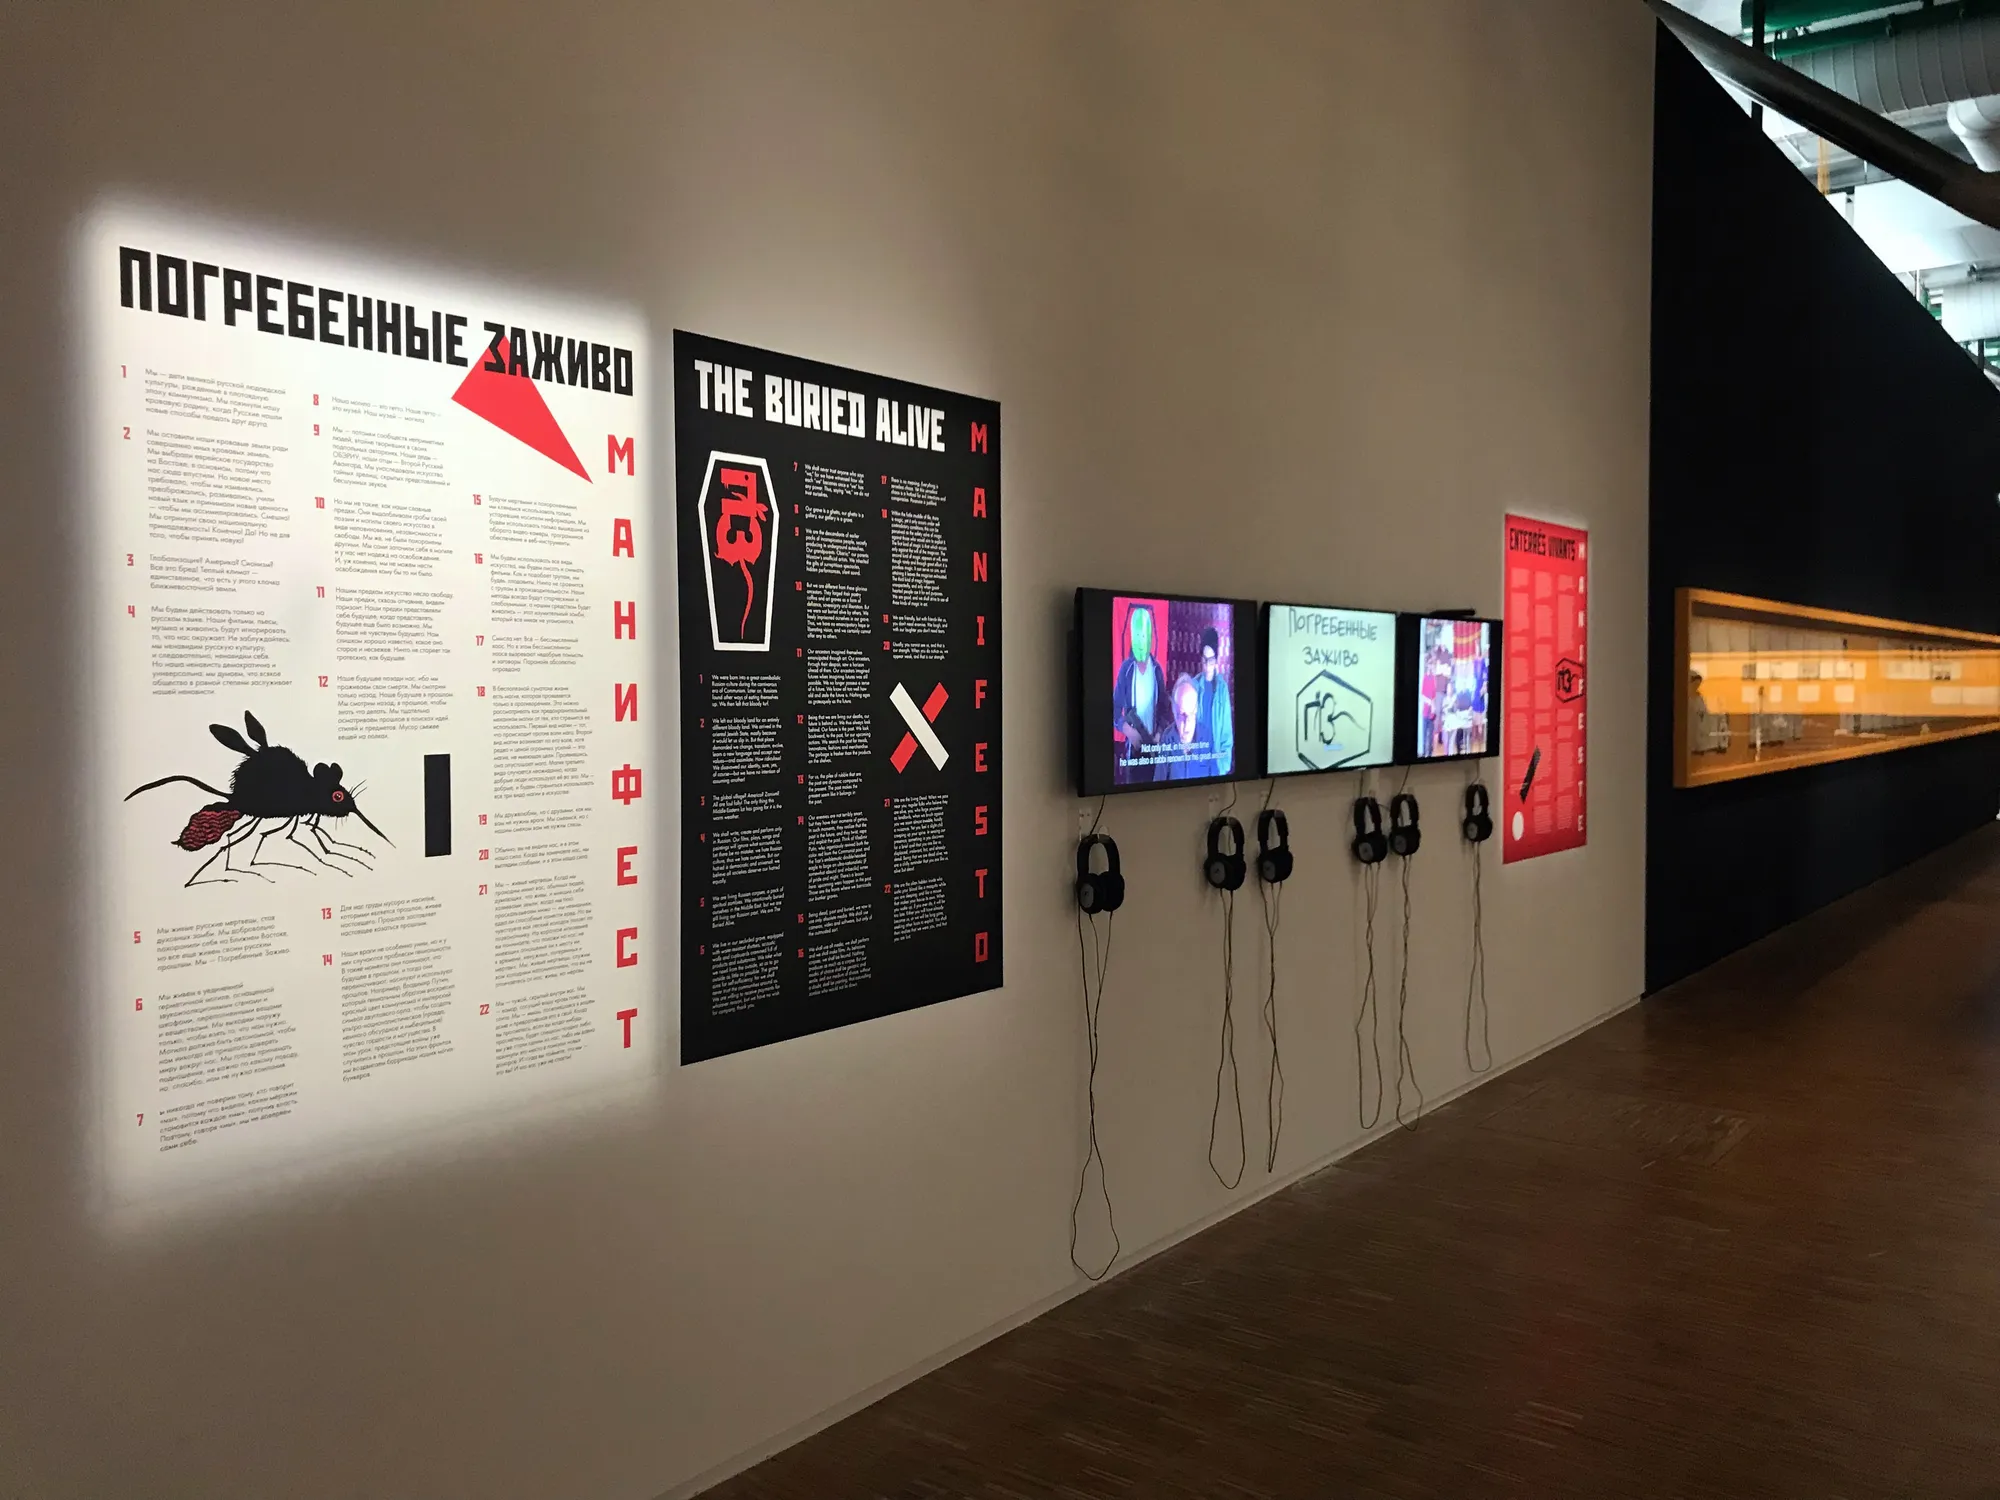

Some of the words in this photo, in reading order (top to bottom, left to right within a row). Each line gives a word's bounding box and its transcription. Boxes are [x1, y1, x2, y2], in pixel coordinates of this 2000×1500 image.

[119, 246, 468, 367] ПОГРЕБЕННЫЕ
[484, 321, 633, 396] ЗАЖИВО
[121, 366, 127, 378] 1
[313, 394, 319, 406] 8
[694, 359, 753, 418] THE
[765, 374, 866, 438] BURIED
[876, 397, 945, 452] ALIVE
[123, 426, 131, 440] 2
[313, 424, 320, 436] 9
[315, 497, 325, 509] 10
[472, 494, 481, 505] 15
[127, 554, 134, 566] 3
[474, 553, 483, 564] 16
[316, 586, 325, 597] 11
[127, 606, 135, 618] 4
[1289, 607, 1378, 641] ПОГРЕБЕННЫЕ
[476, 635, 484, 646] 17
[318, 675, 328, 688] 12
[477, 686, 485, 697] 18
[1141, 744, 1151, 752] Not
[1152, 744, 1162, 754] only
[1120, 758, 1127, 766] he
[1128, 758, 1138, 766] was
[1139, 757, 1149, 765] also
[479, 814, 487, 825] 19
[479, 849, 489, 861] 20
[479, 884, 488, 895] 21
[322, 908, 332, 919] 13
[134, 931, 141, 944] 5
[322, 954, 332, 966] 14
[136, 998, 142, 1011] 6
[480, 1004, 490, 1015] 22
[137, 1114, 144, 1126] 7
